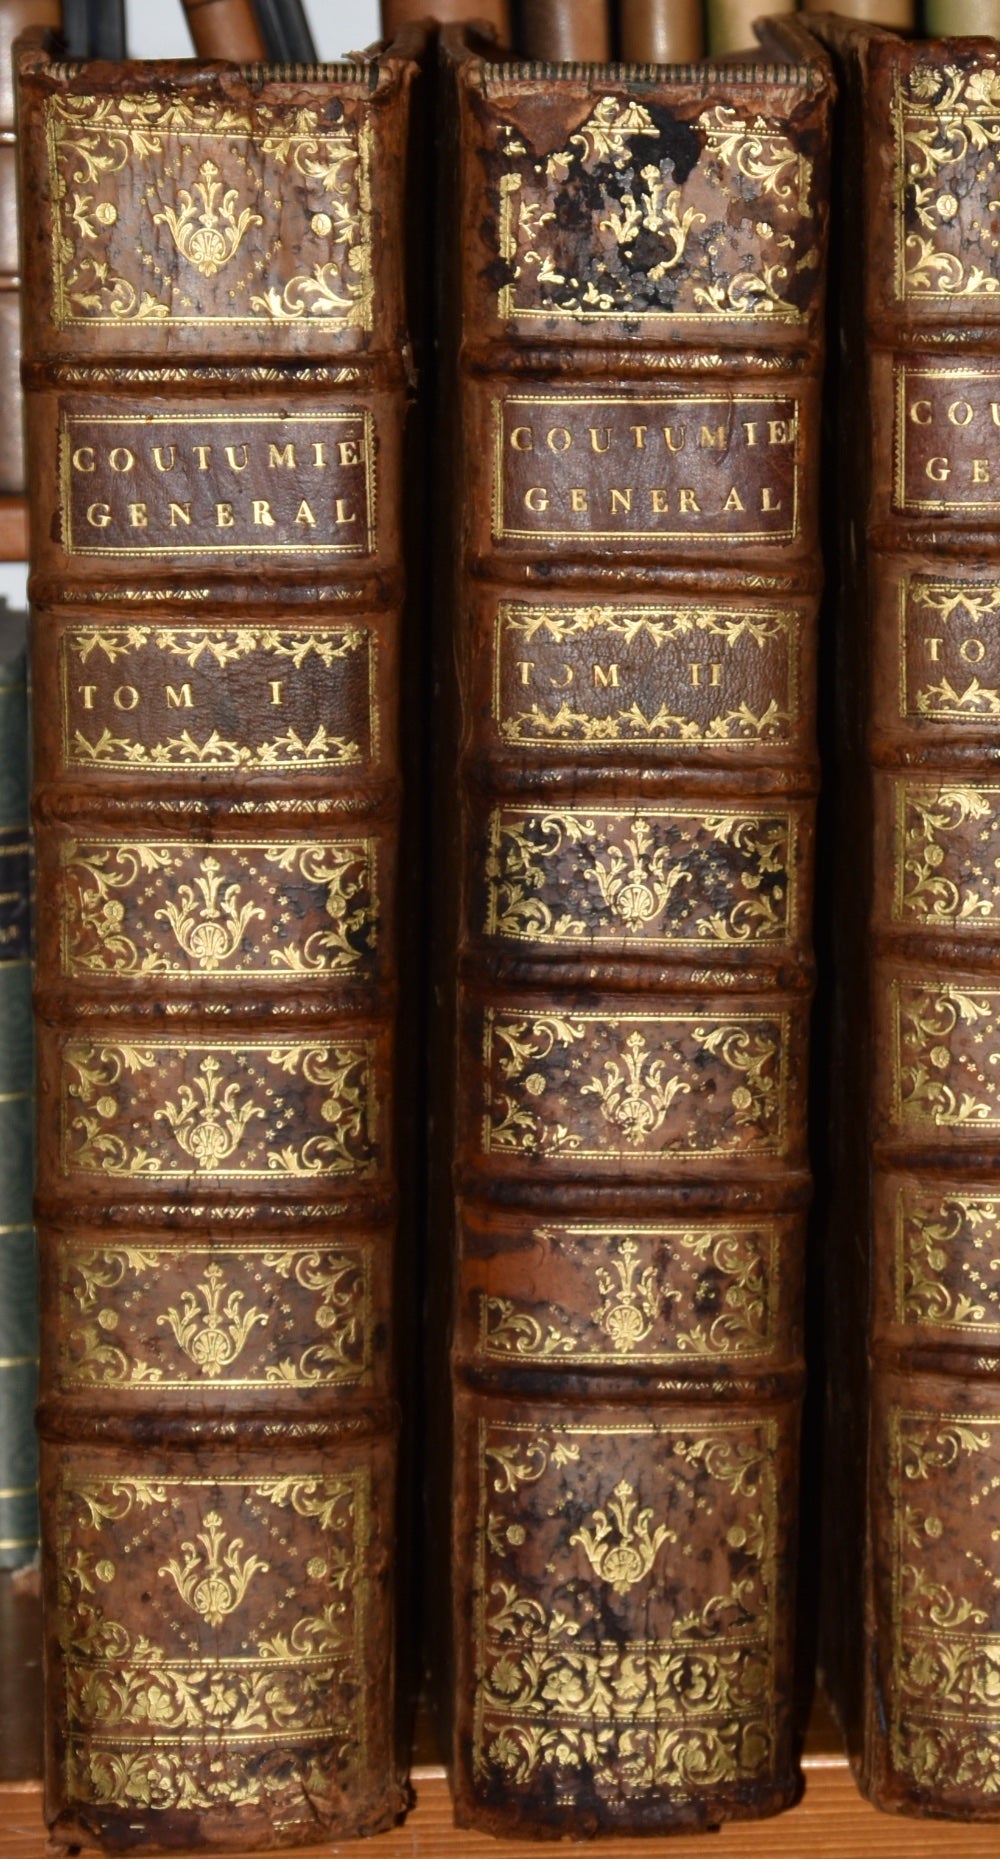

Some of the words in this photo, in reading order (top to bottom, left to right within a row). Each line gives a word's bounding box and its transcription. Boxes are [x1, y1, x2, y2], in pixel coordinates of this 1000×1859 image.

[86, 499, 357, 528] GENERAL
[523, 486, 782, 514] GENERAL
[516, 661, 621, 688] TOM
[689, 662, 722, 687] II
[78, 682, 193, 711] TOM
[269, 680, 284, 706] I
